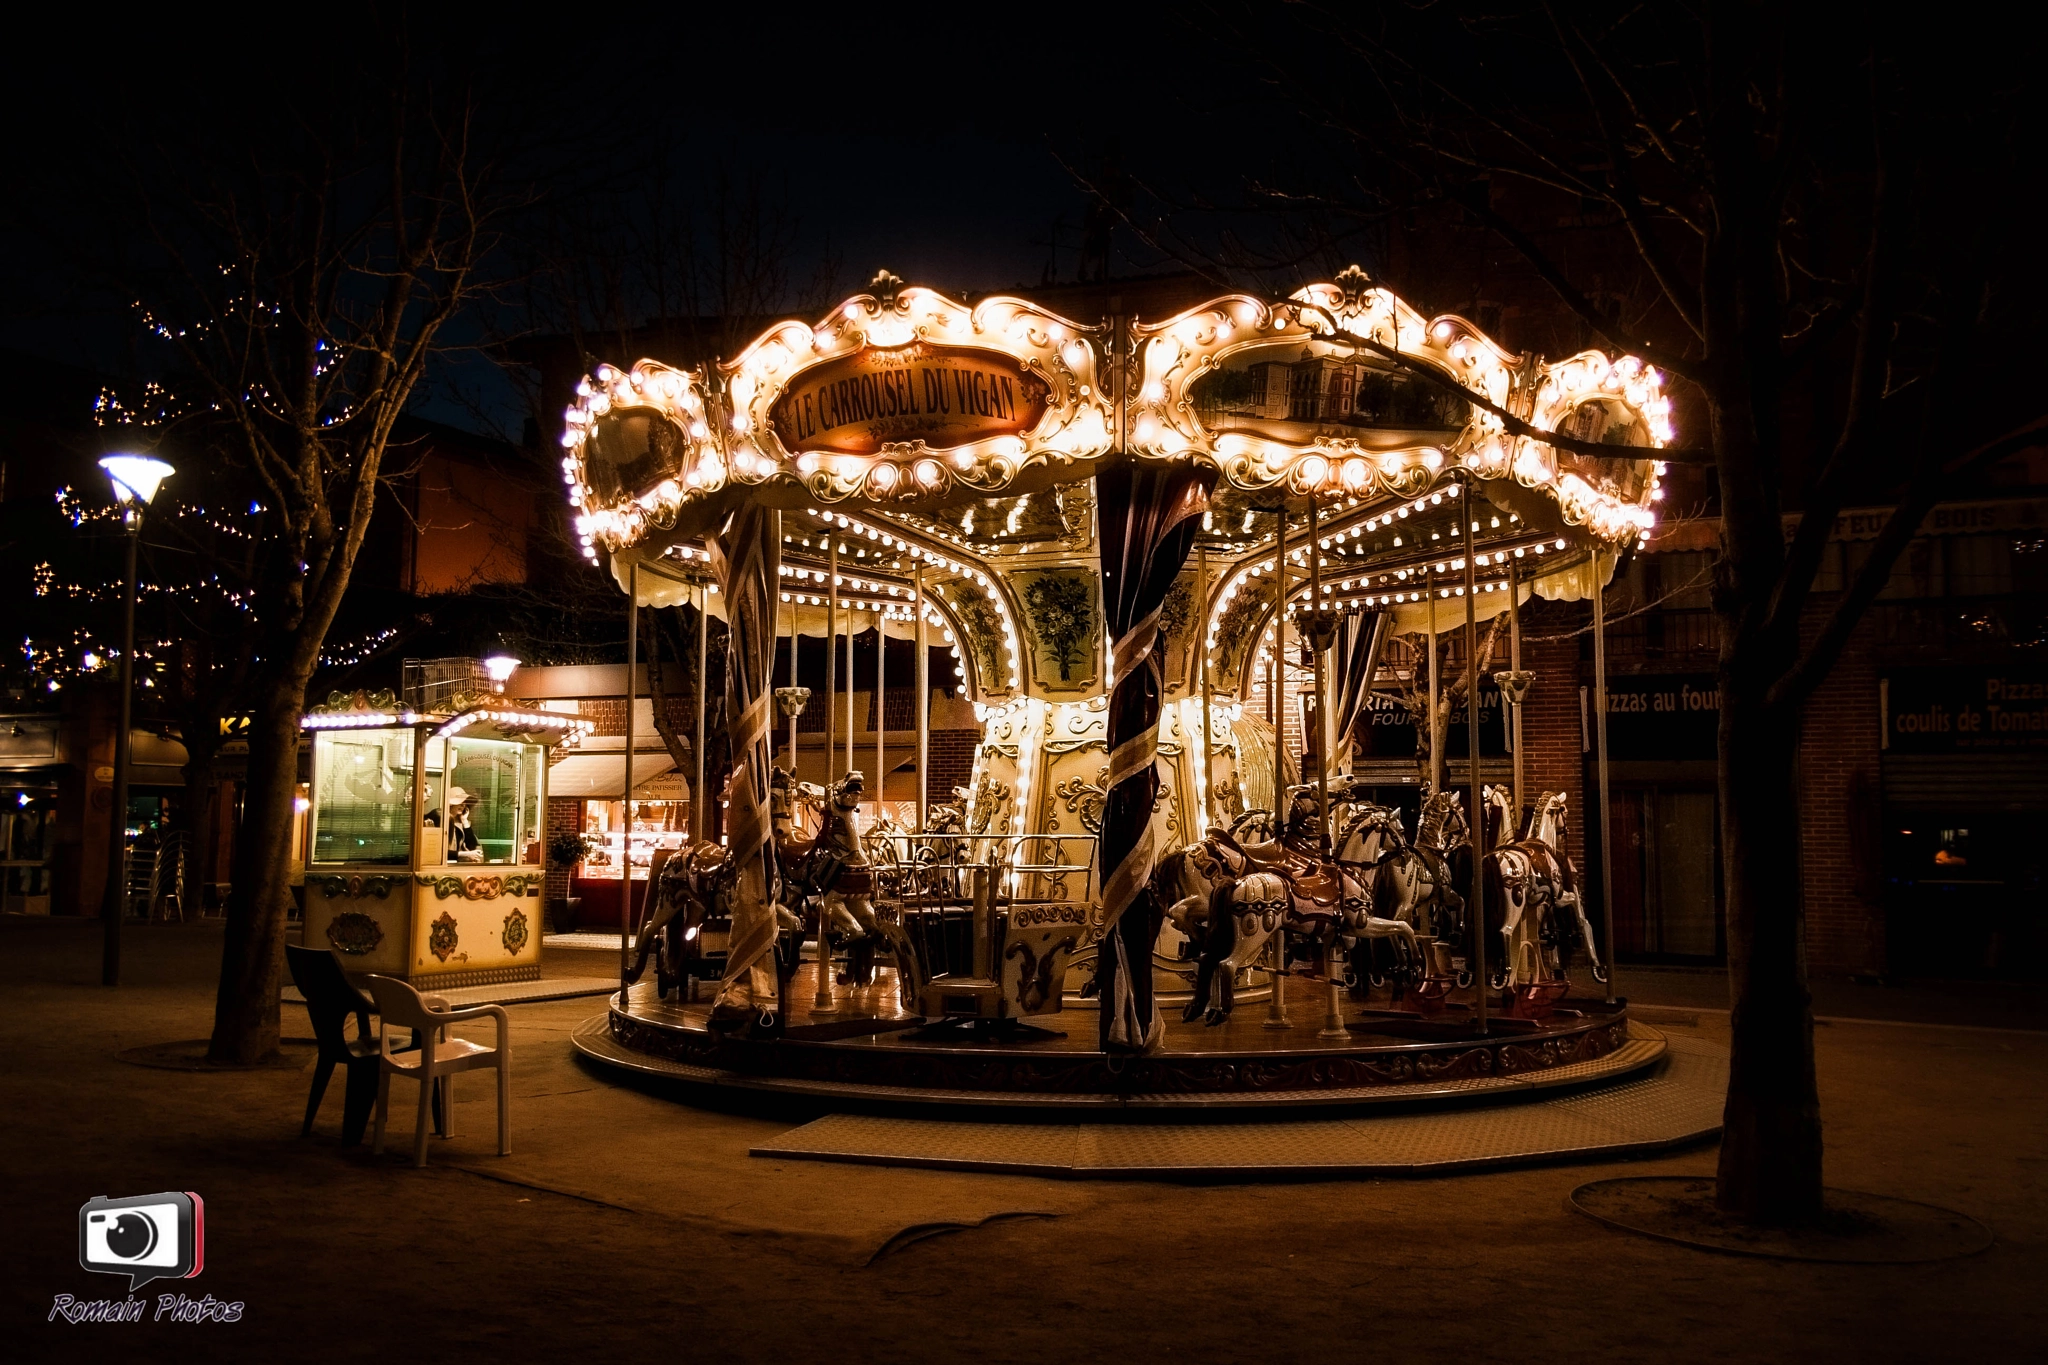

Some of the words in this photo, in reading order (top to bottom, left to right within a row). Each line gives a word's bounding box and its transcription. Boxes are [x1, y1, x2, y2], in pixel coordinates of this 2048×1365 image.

[794, 390, 816, 441] LE
[818, 369, 921, 431] CARROUSEL
[923, 368, 951, 414] DU
[953, 369, 1016, 421] VIGAN
[1936, 508, 1996, 527] BOIS
[1307, 694, 1394, 712] PRIA
[1593, 685, 1648, 712] izzas
[1653, 692, 1676, 712] au
[1450, 710, 1490, 724] BOS
[1896, 703, 1951, 733] coulis
[1957, 703, 1982, 733] de
